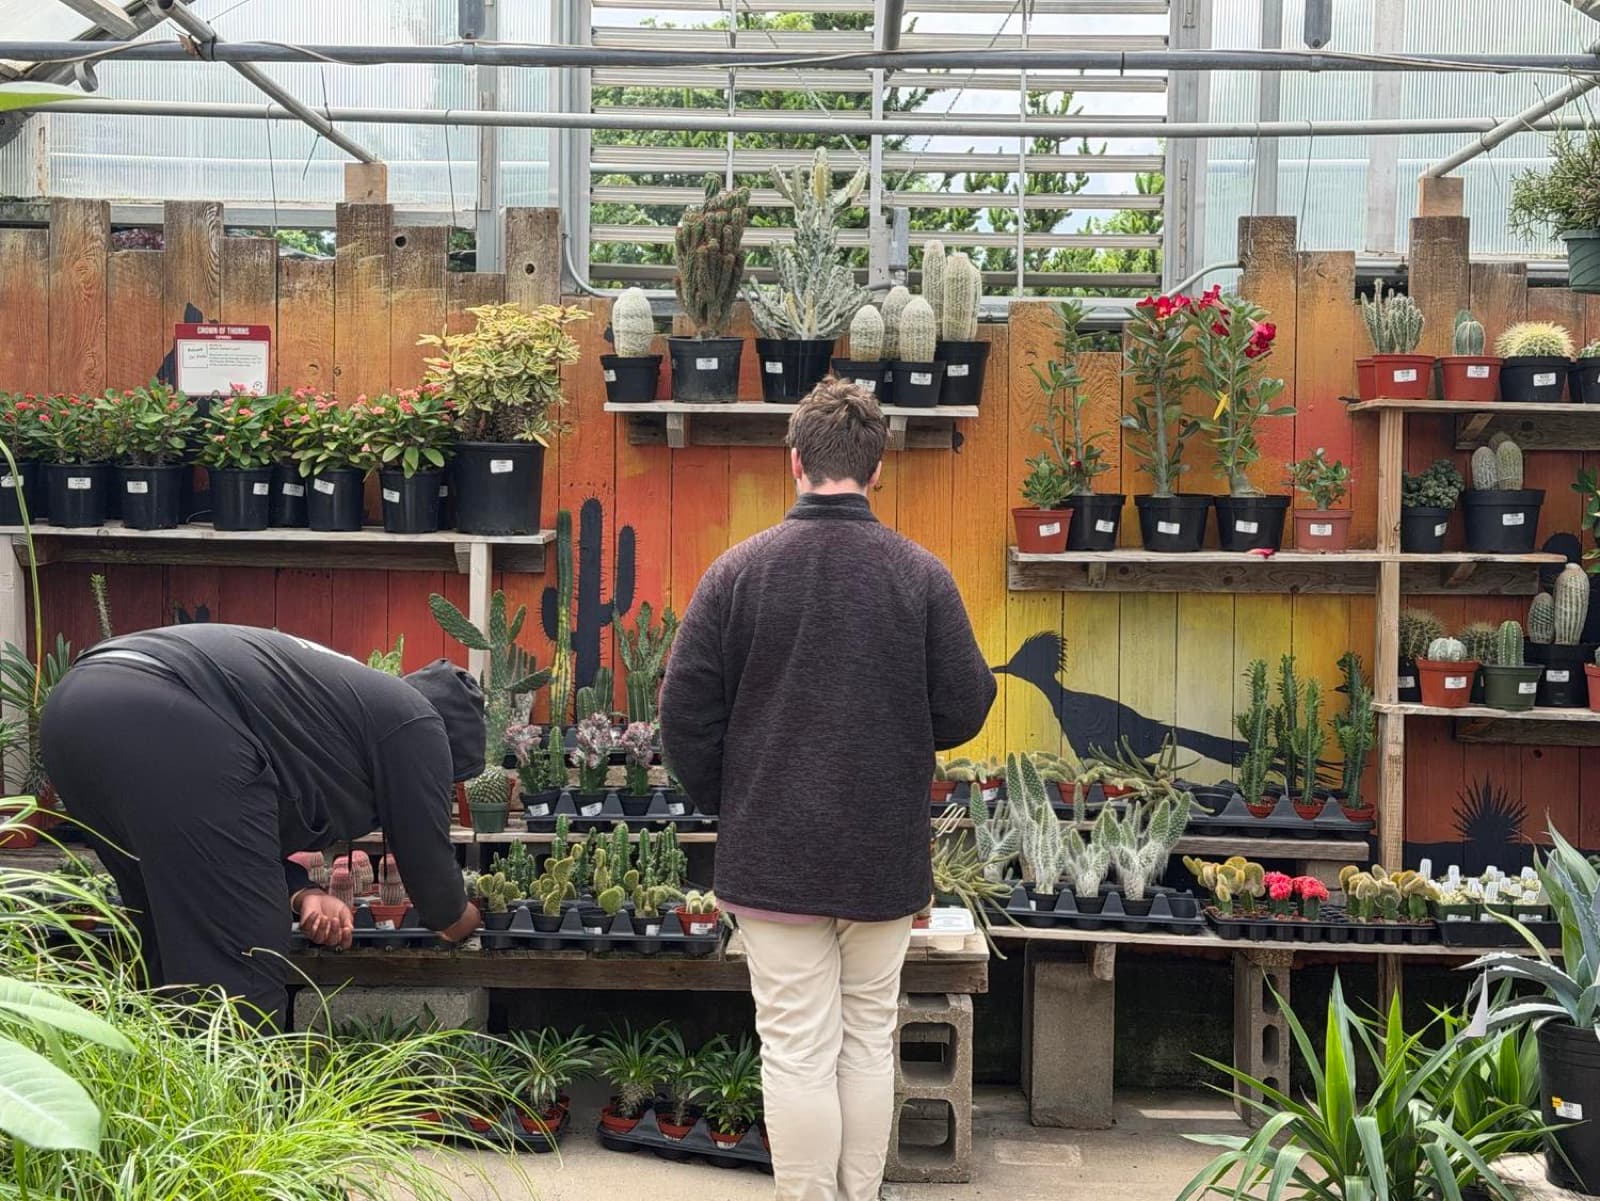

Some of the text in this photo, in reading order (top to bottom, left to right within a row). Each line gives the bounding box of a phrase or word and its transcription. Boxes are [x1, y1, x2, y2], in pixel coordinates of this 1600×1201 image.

[197, 326, 250, 335] CROWN OF THORNS
